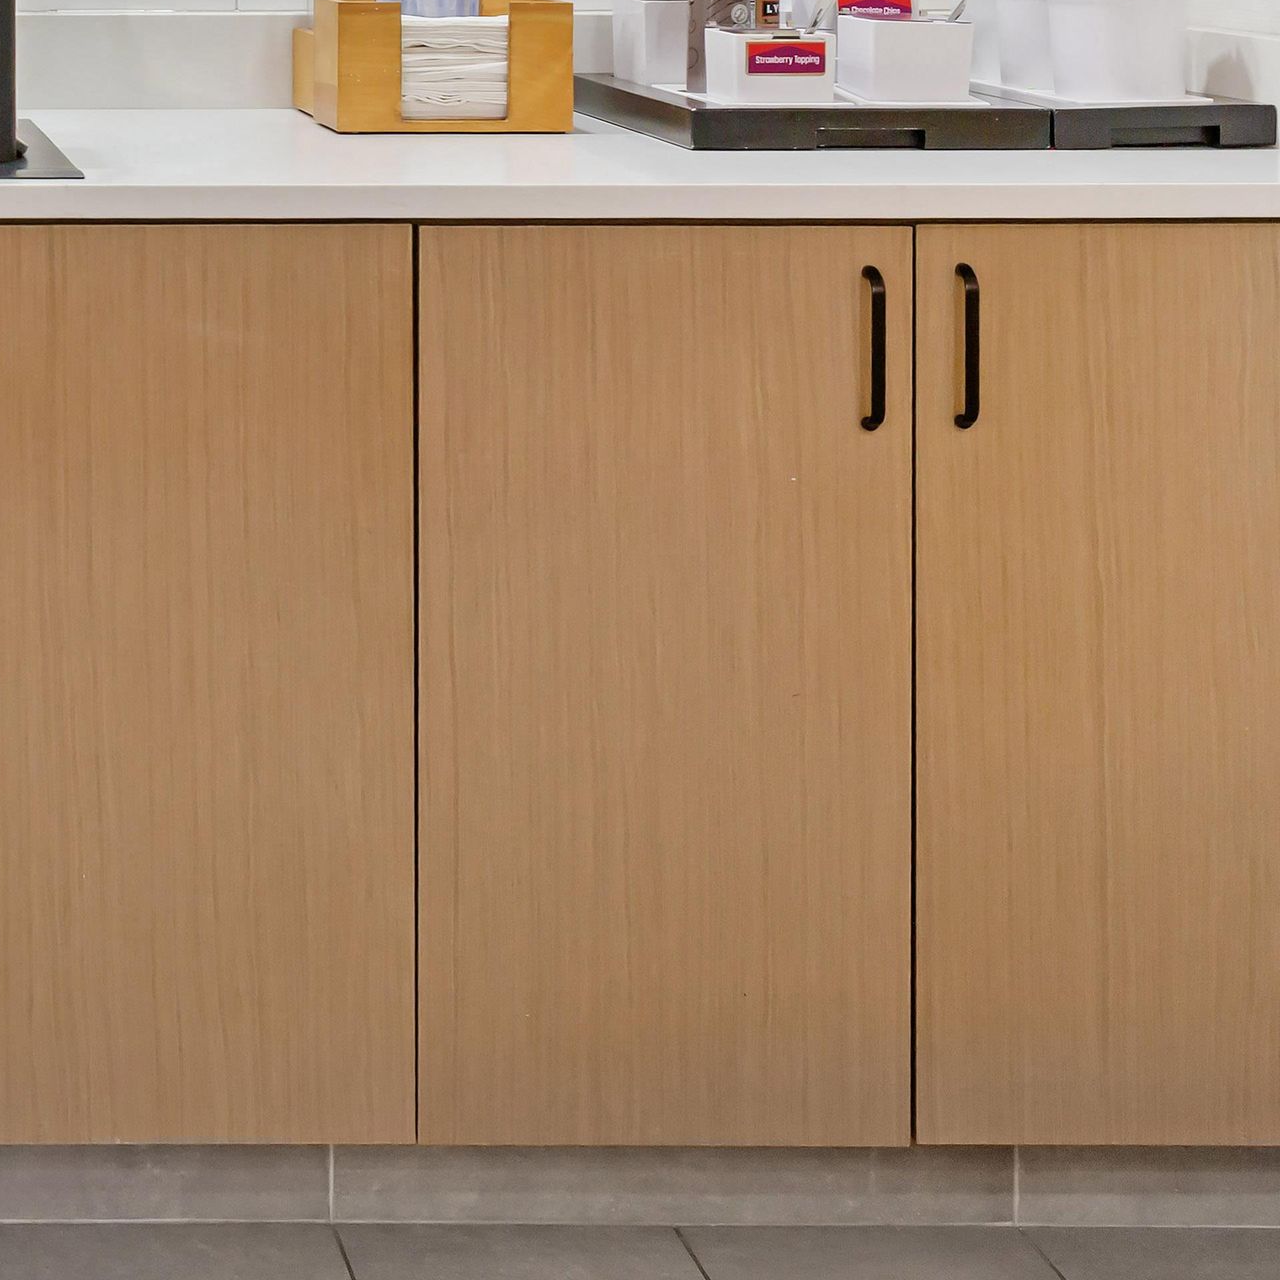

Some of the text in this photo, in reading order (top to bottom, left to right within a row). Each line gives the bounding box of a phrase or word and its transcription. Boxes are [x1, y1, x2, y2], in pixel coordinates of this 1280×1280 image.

[766, 4, 779, 14] LY
[850, 5, 883, 15] Chocolate
[754, 54, 821, 66] Strawberry Topping
